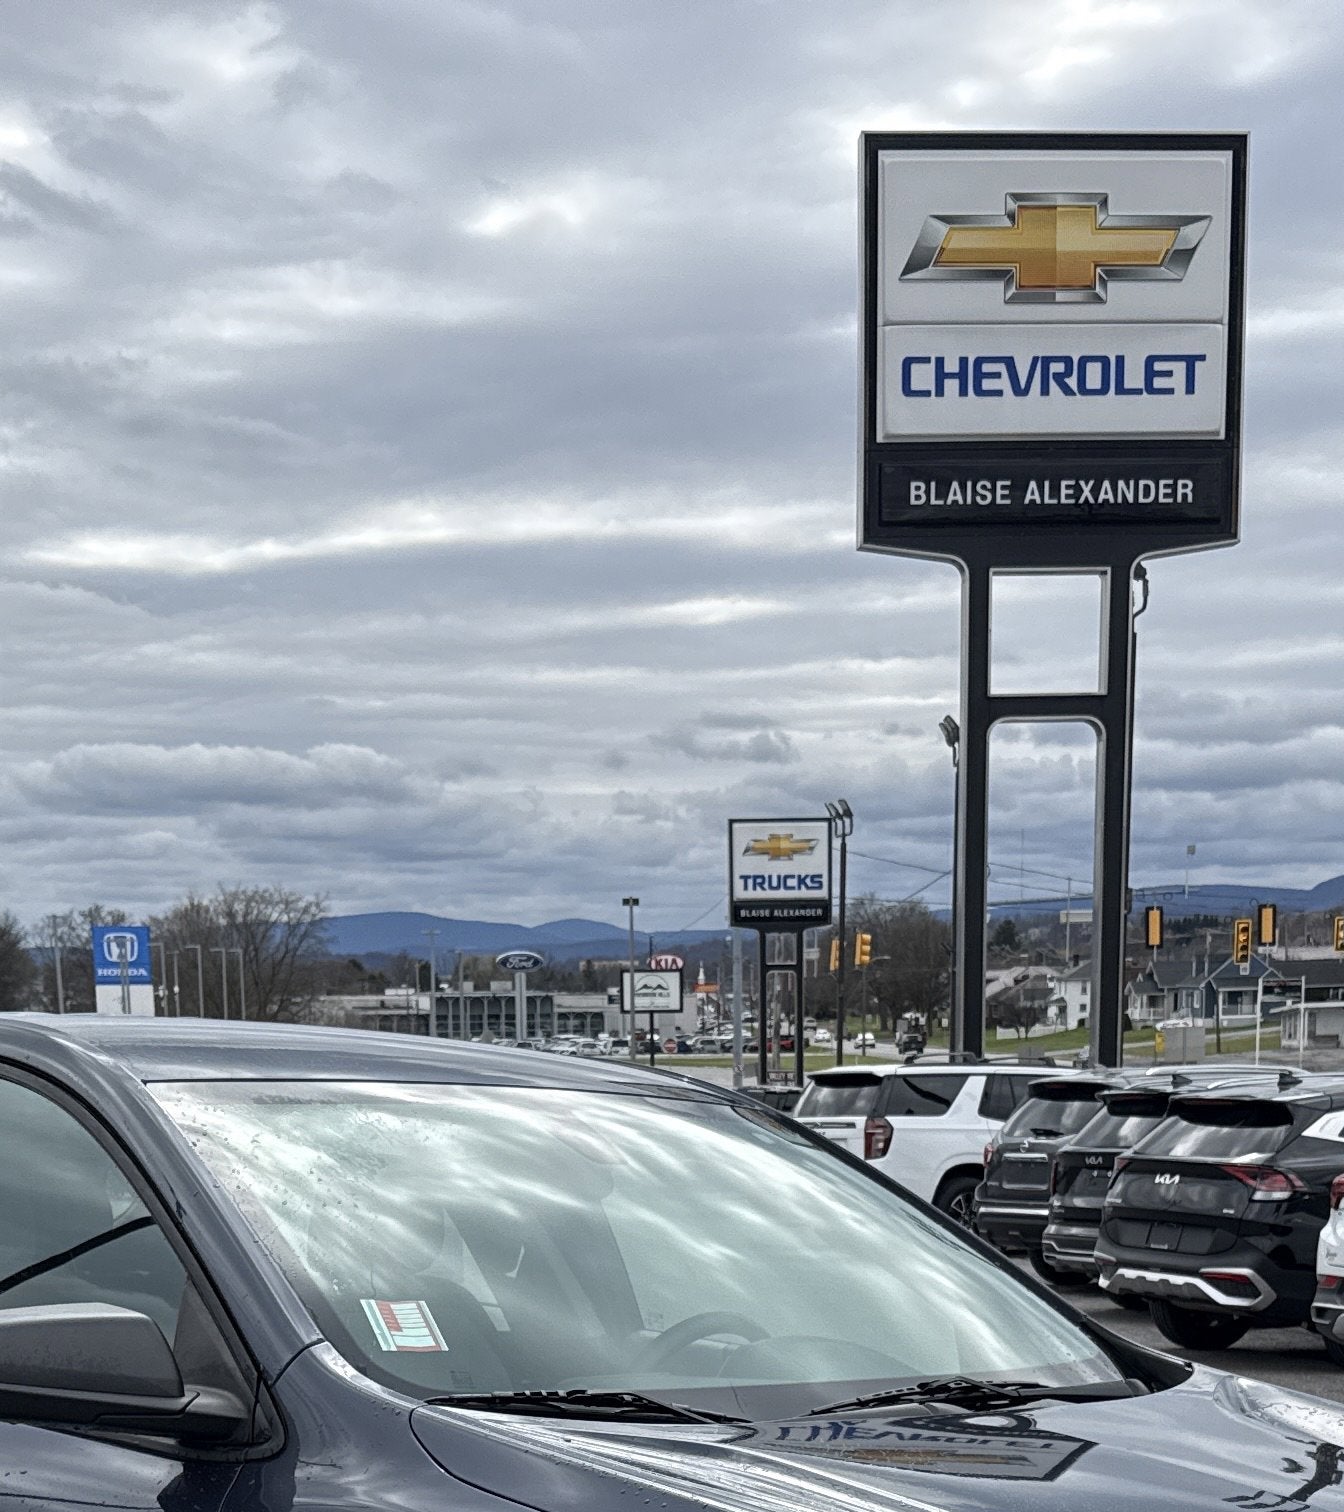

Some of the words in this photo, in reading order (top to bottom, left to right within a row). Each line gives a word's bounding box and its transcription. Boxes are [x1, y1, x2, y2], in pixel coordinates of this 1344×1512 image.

[901, 354, 1206, 397] CHEVROLET
[909, 481, 1011, 506] BLAISE
[1024, 479, 1193, 505] ALEXANDER
[739, 874, 823, 891] TRUCKS
[740, 909, 770, 918] BLAISE
[773, 908, 823, 917] ALEXANDER
[506, 956, 535, 969] Ford
[655, 957, 680, 970] KIA
[1155, 1173, 1180, 1185] KIA
